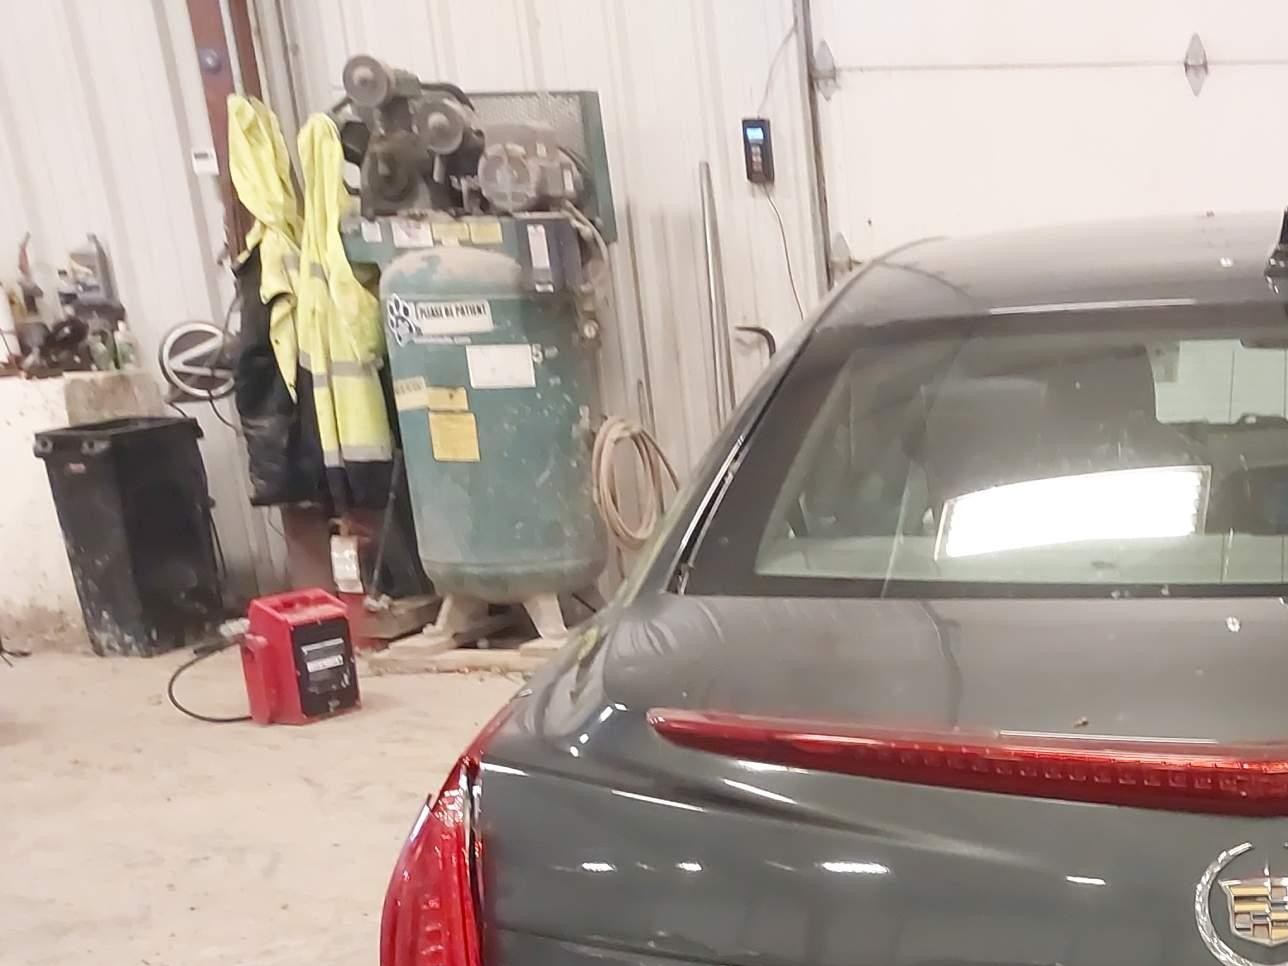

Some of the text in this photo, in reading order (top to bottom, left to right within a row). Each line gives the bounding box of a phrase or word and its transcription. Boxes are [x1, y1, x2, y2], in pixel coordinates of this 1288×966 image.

[419, 303, 487, 320] PLEASE BE PATIENT
